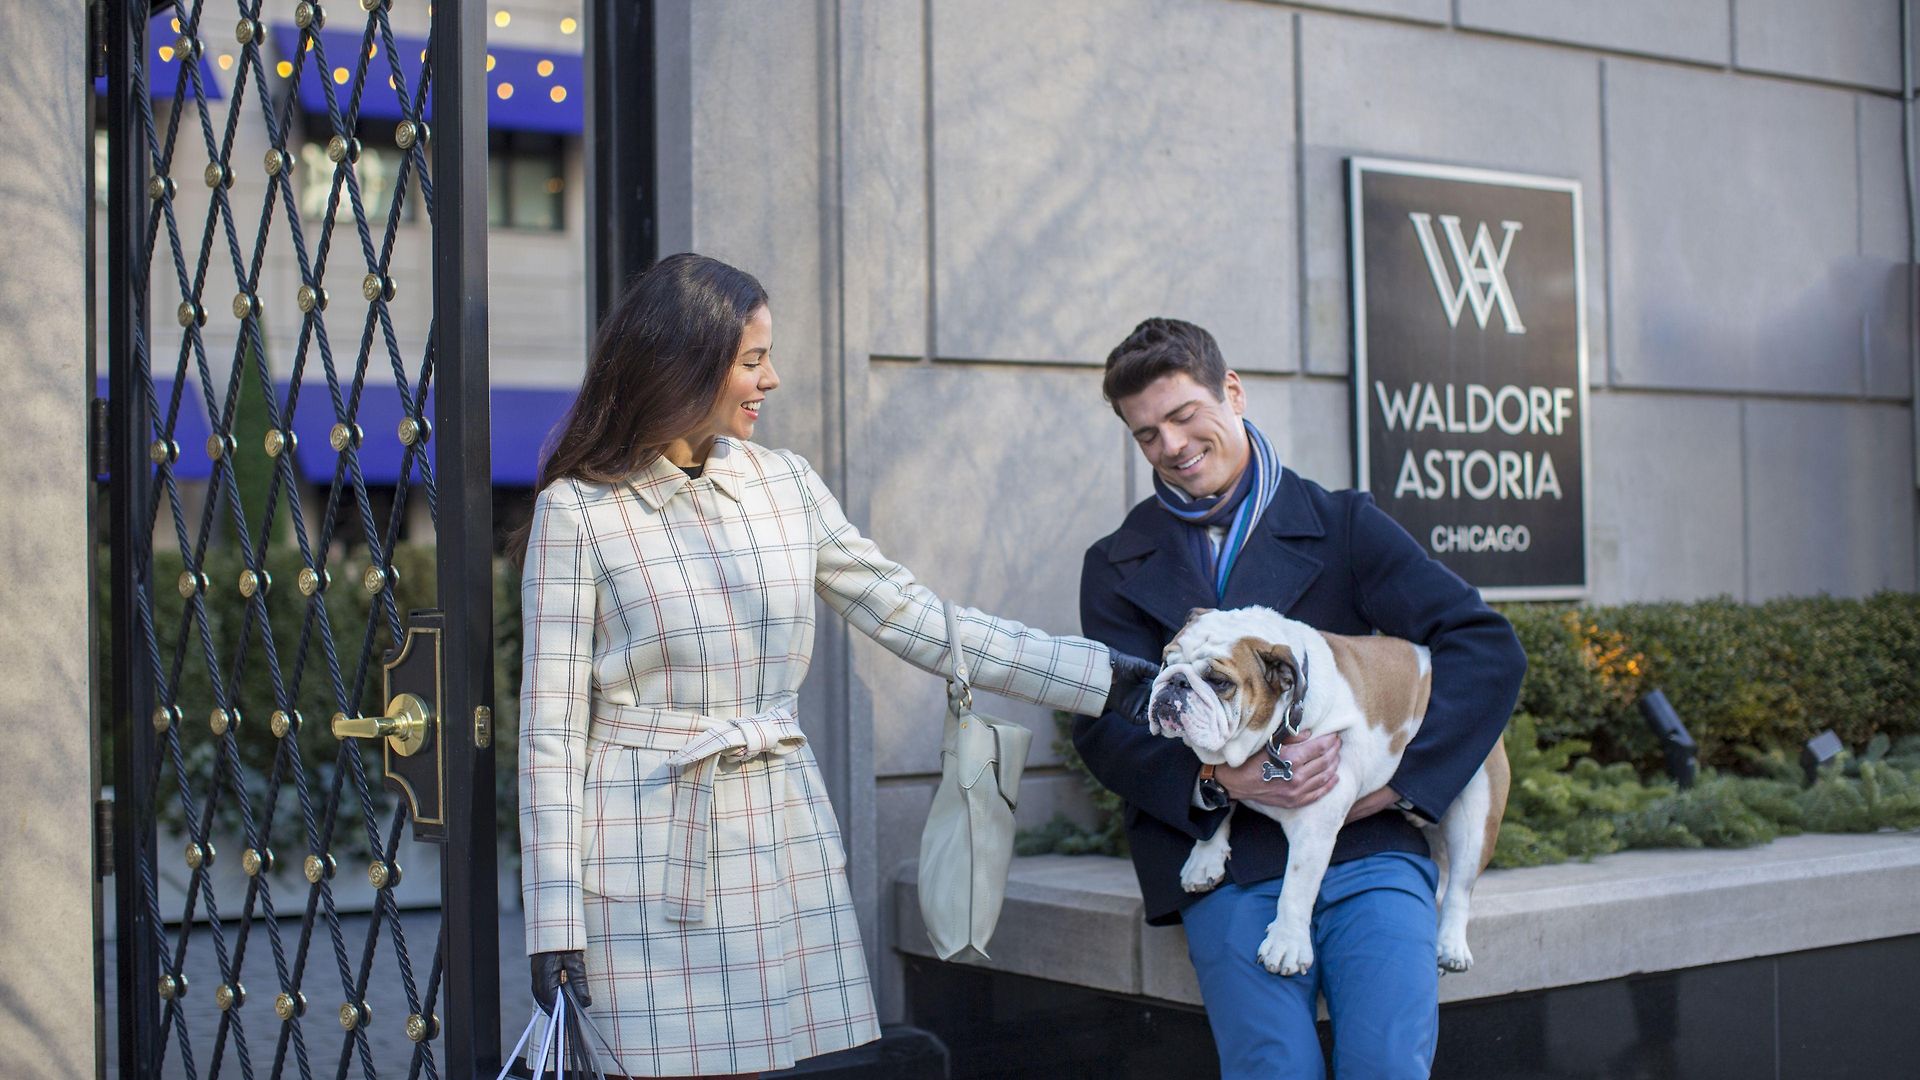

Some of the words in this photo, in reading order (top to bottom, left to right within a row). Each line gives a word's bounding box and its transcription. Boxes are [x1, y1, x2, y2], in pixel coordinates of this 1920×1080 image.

[1375, 380, 1574, 436] WALDORF
[1395, 449, 1562, 500] ASTORIA
[1431, 525, 1531, 553] CHICAGO
